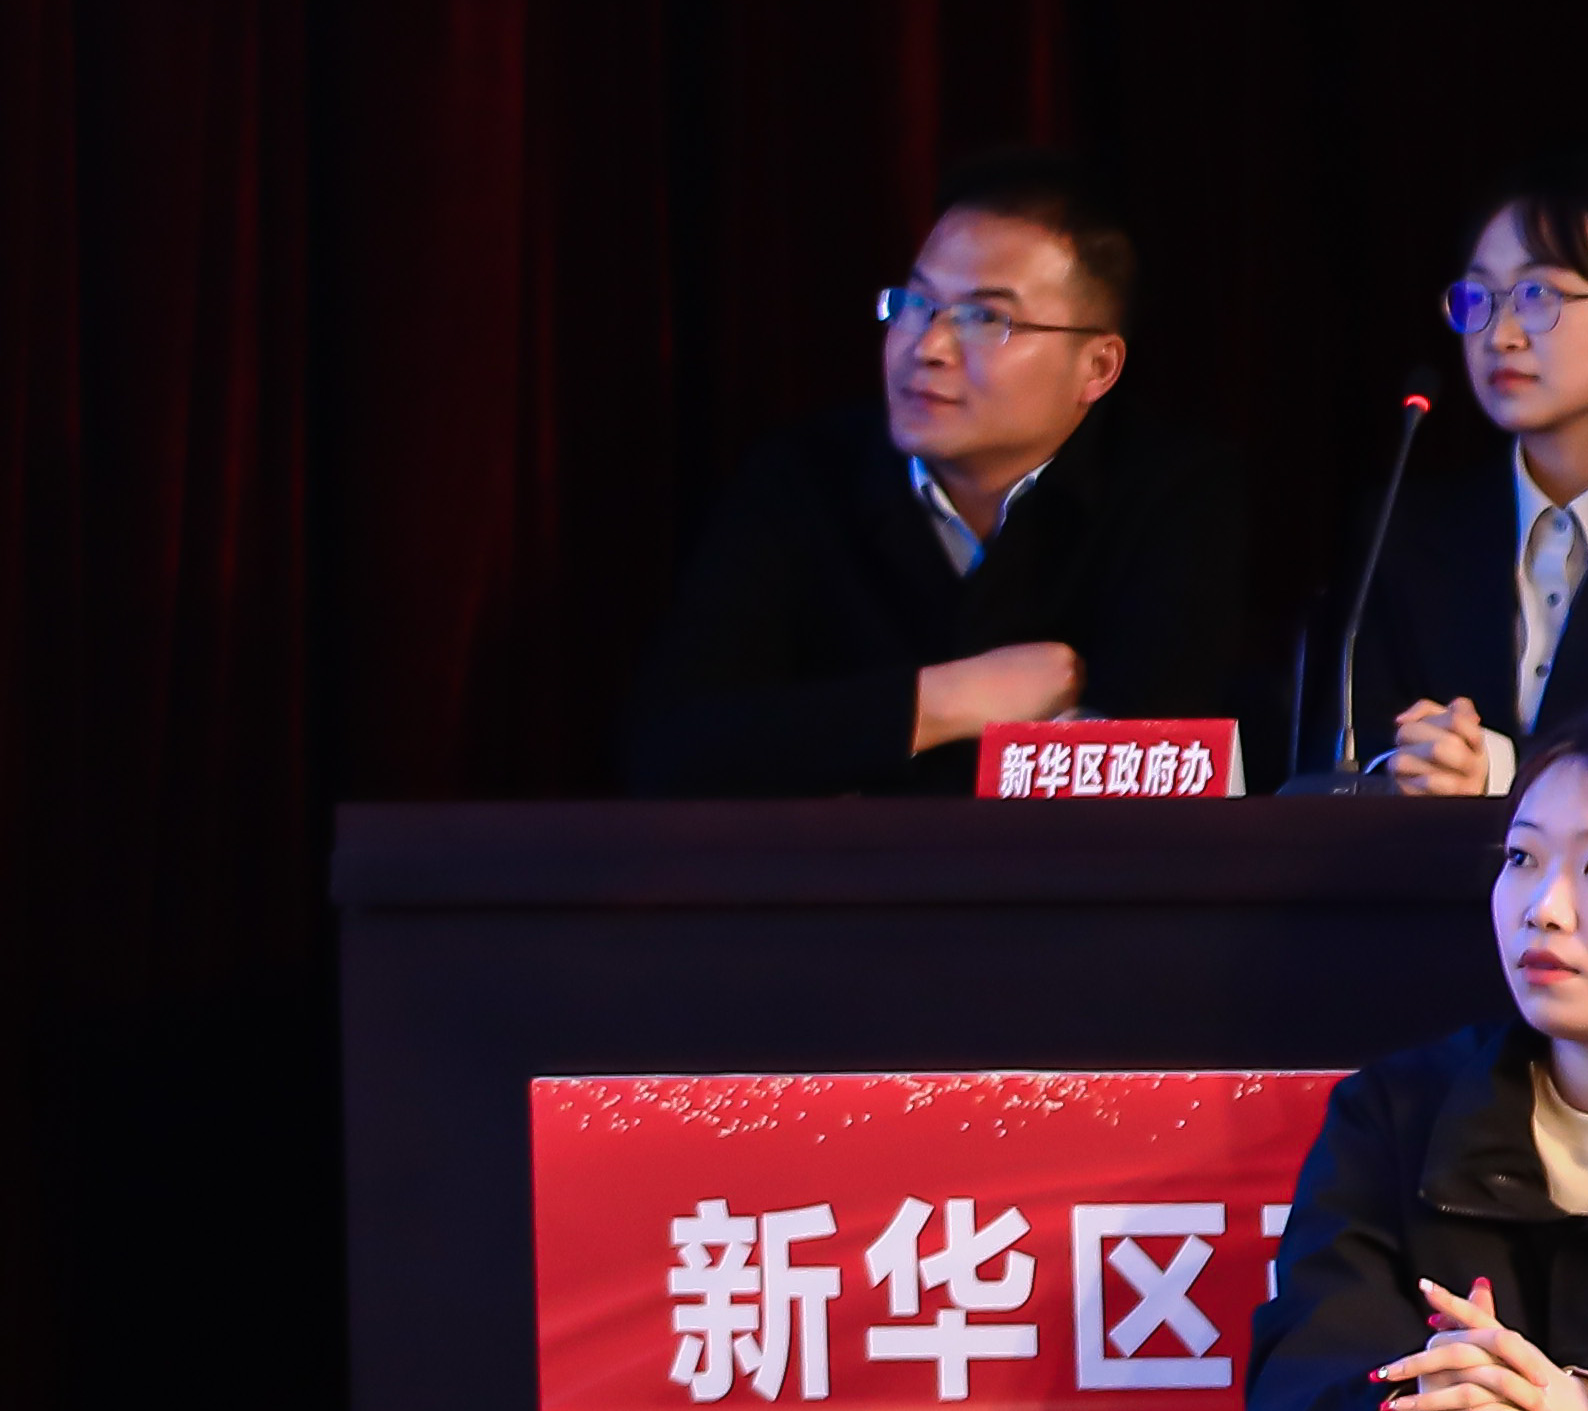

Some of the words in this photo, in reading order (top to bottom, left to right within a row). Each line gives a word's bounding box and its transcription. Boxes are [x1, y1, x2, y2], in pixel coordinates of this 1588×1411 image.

[1000, 740, 1214, 798] 新华区政府办
[666, 1197, 1293, 1402] 新华区
